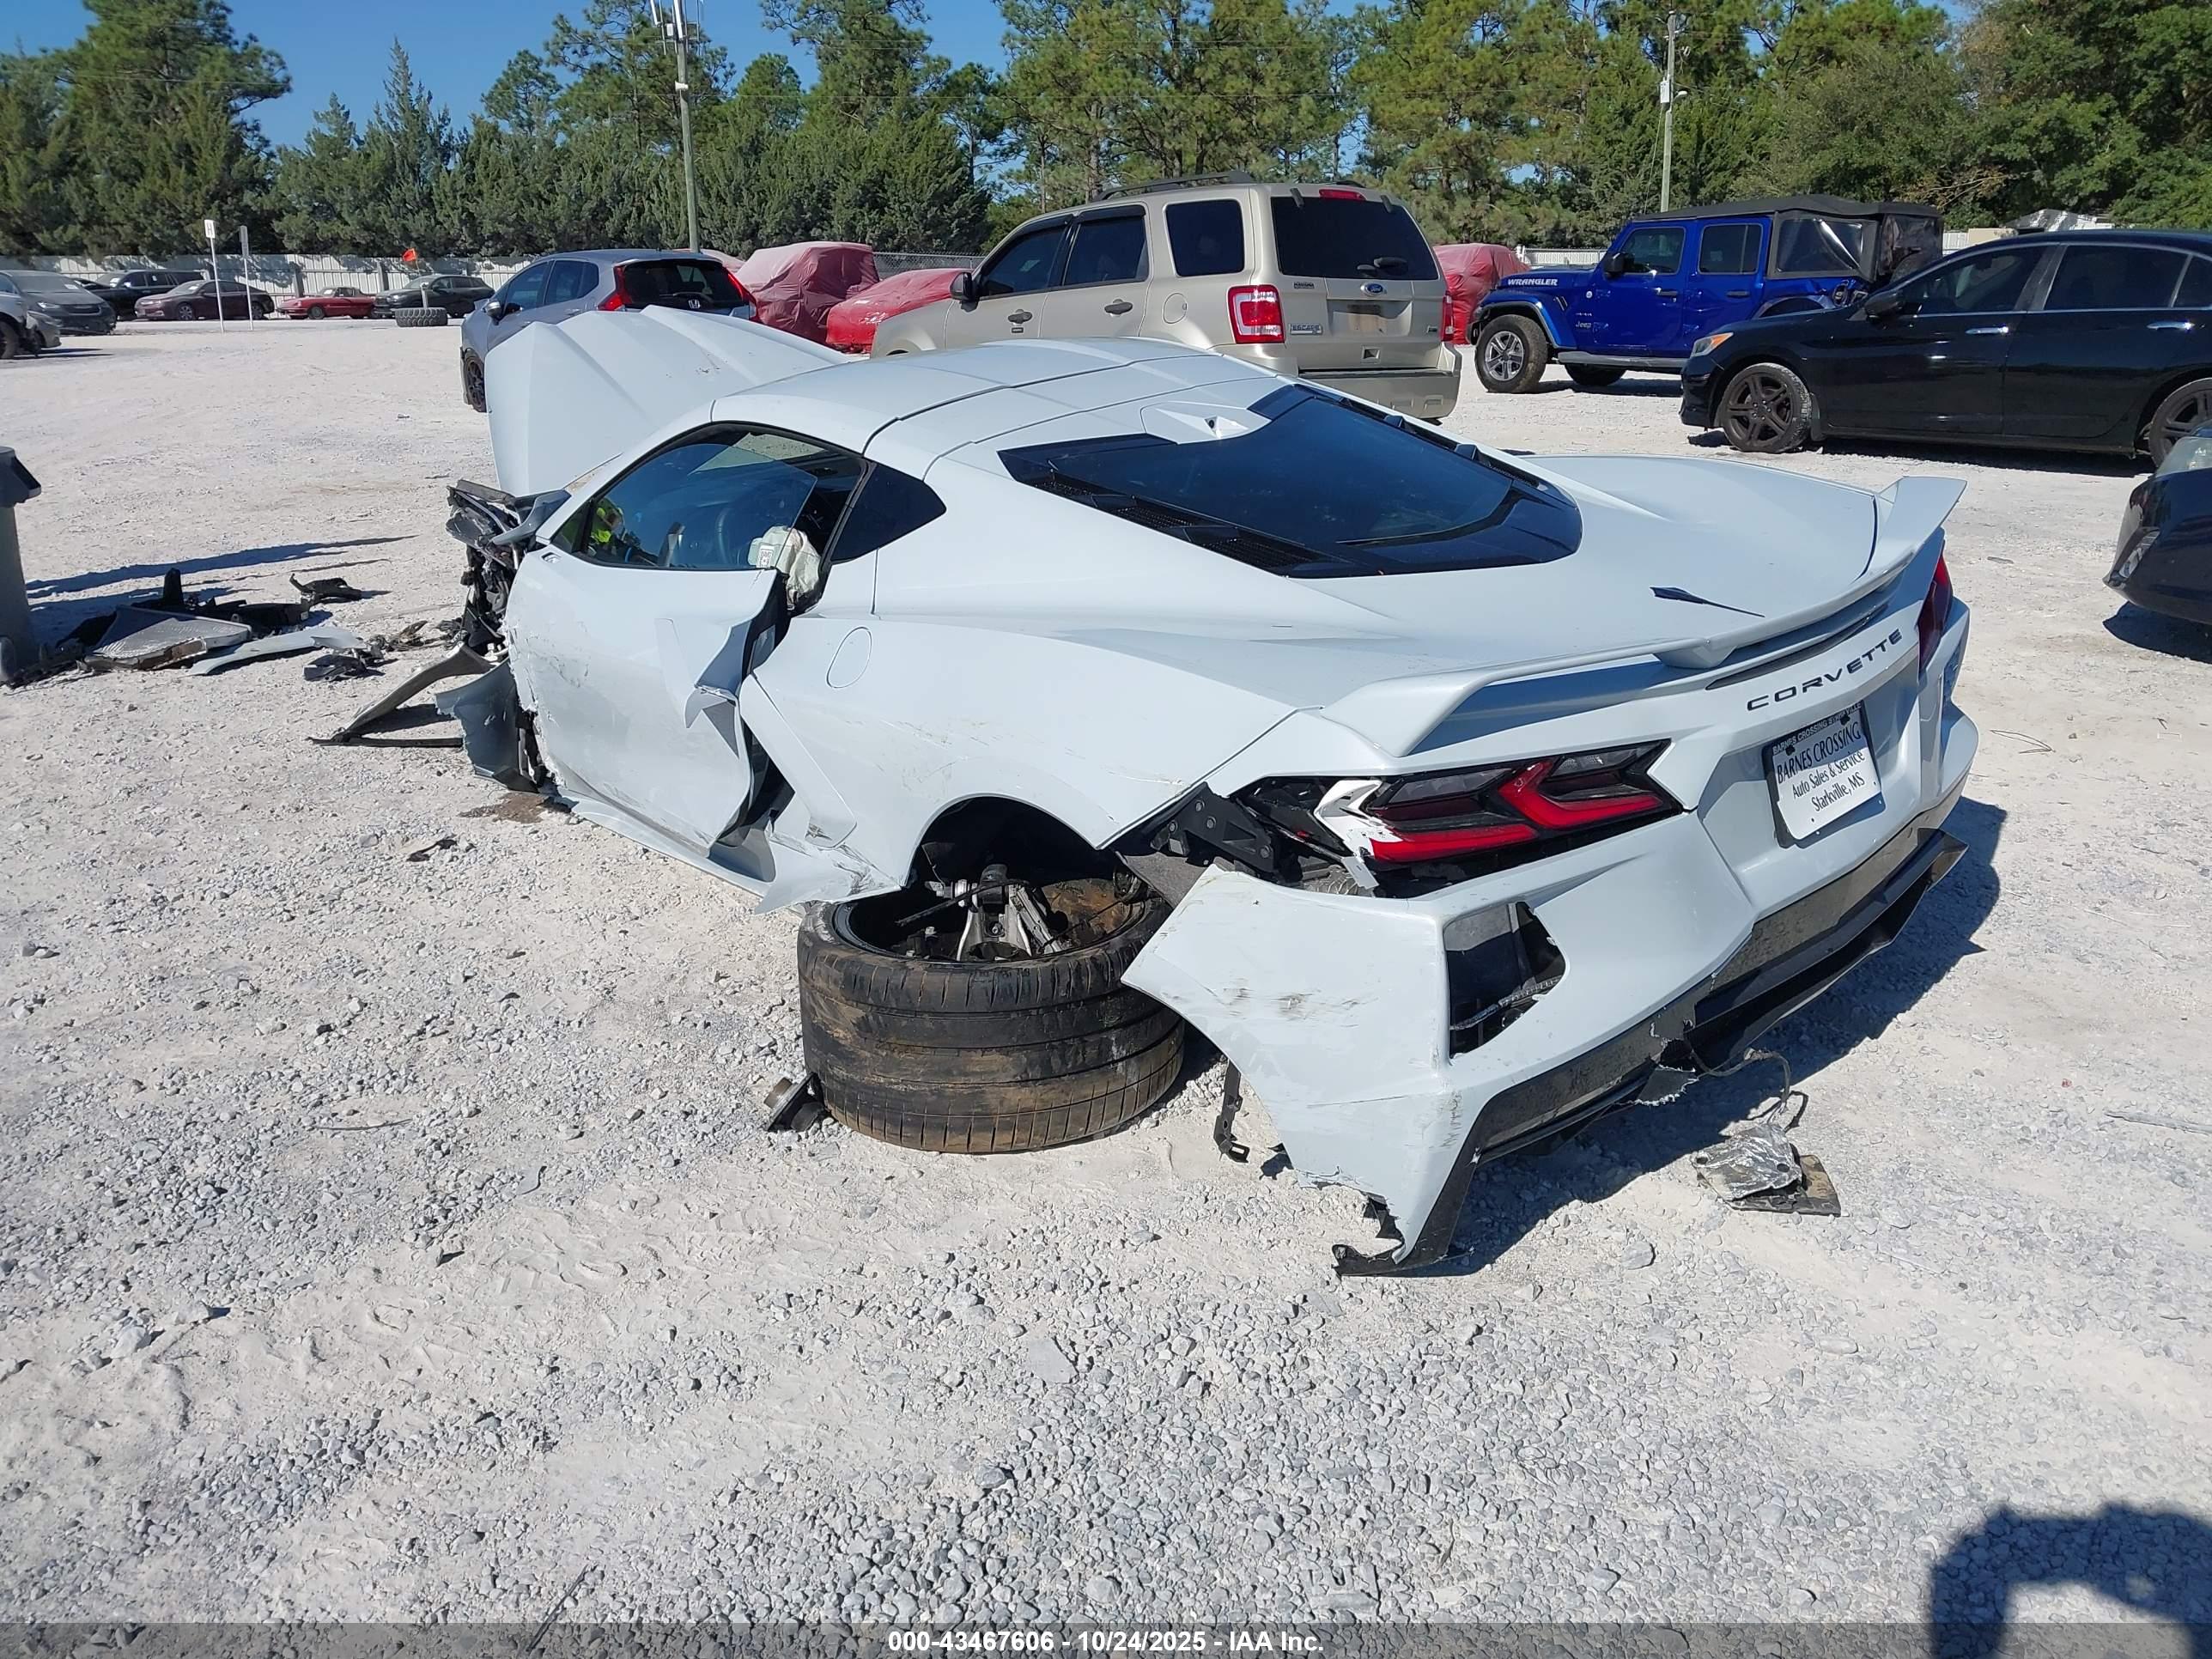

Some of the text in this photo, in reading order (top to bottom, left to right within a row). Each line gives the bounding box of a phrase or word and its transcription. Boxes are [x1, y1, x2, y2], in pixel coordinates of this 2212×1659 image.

[1575, 320, 1592, 330] Jeep
[1747, 628, 1903, 711] CORVETTE
[1777, 722, 1862, 784] BARNES CROSSING
[1797, 720, 1828, 741] CROSSING
[1792, 750, 1866, 799] Auto Sales & Service
[1812, 771, 1866, 812] Starkville, MS
